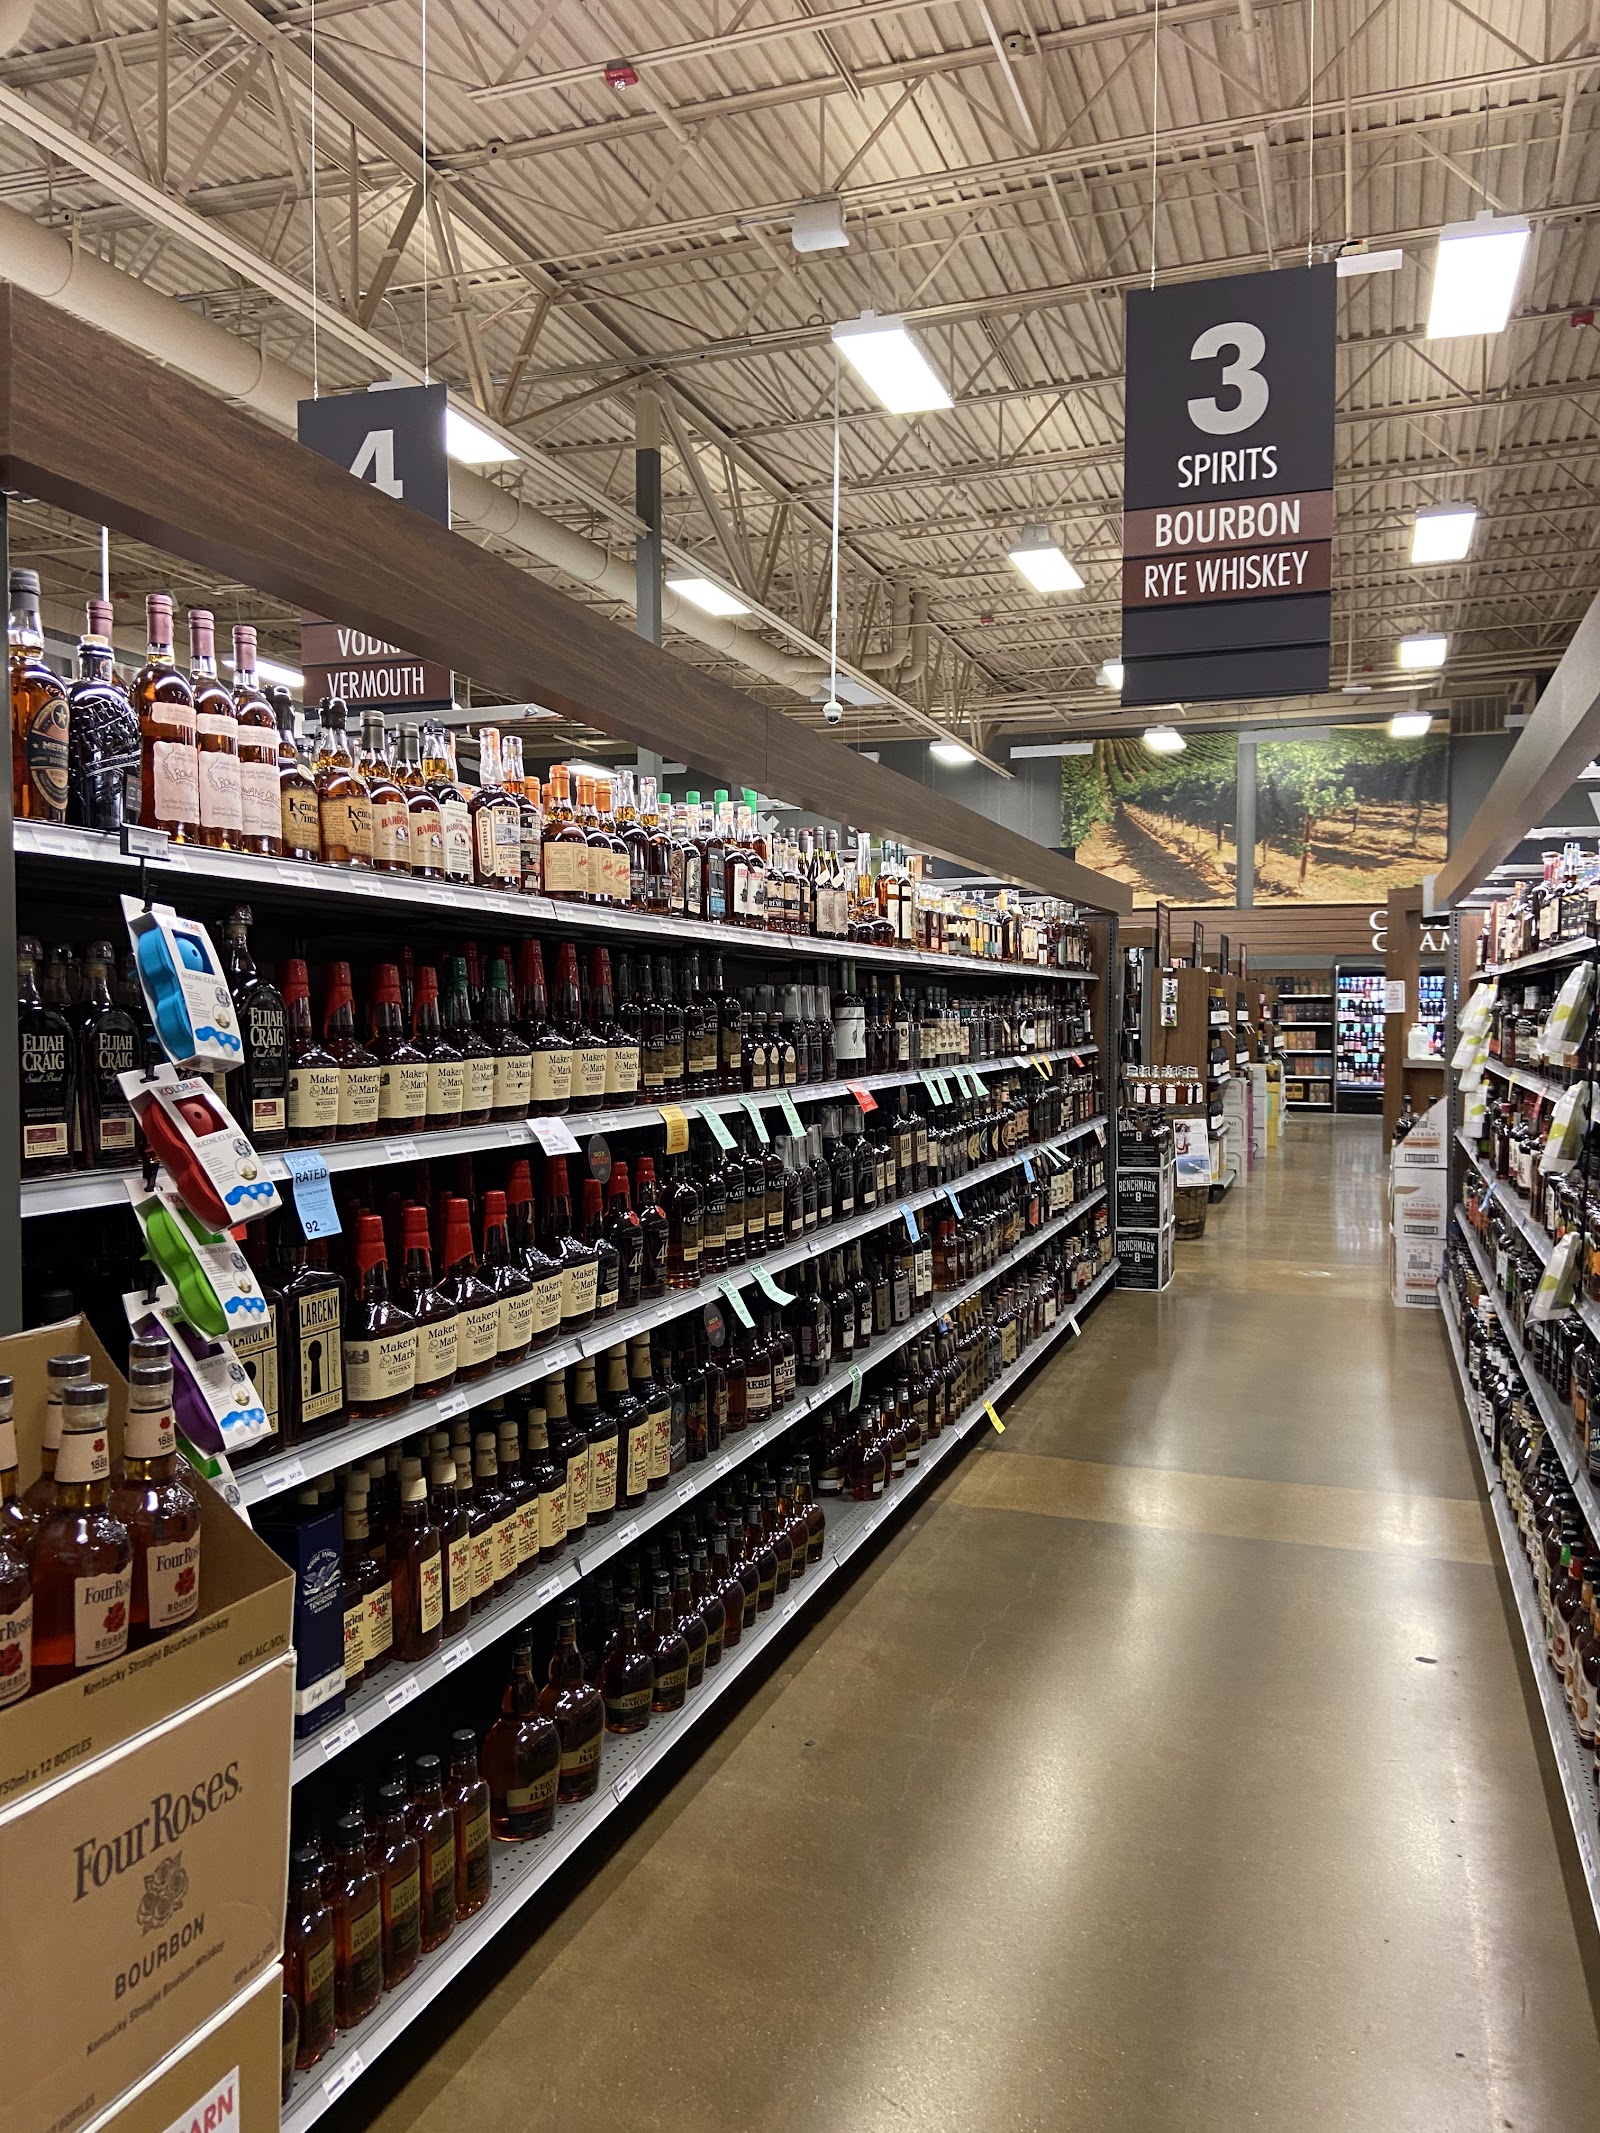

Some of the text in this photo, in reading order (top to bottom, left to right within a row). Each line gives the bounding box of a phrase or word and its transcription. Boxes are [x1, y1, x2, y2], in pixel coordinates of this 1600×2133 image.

[1187, 321, 1269, 435] 3
[349, 428, 404, 499] 4
[1177, 445, 1278, 488] SPIRITS
[1155, 499, 1300, 548] BOURBON
[1144, 550, 1309, 599] RYE WHISKEY
[326, 666, 425, 701] VERMOUTH
[250, 1007, 284, 1031] ELIJAH
[22, 1033, 65, 1055] ELIJAH
[99, 1032, 133, 1054] ELIJAH
[250, 1025, 284, 1048] CRAIG
[22, 1051, 65, 1073] CRAIG
[99, 1050, 133, 1070] CRAIG
[589, 1063, 606, 1073] Mark
[622, 1060, 638, 1070] Mark
[556, 1065, 572, 1075] Mark
[158, 1081, 202, 1097] KOLORAE
[320, 1085, 340, 1096] Mark
[358, 1084, 380, 1095] Mark
[194, 1138, 218, 1150] SILICONE
[226, 1131, 242, 1140] BALLS
[288, 1154, 320, 1168] HIGHLY
[295, 1167, 327, 1184] RATED
[1118, 1180, 1158, 1193] BENCHMARK
[305, 1220, 321, 1233] 92
[1117, 1240, 1156, 1254] BENCHMARK
[580, 1278, 597, 1290] Mark
[544, 1291, 562, 1304] Mark
[300, 1295, 338, 1329] LARCENY
[477, 1319, 499, 1335] Mark
[379, 1335, 416, 1355] Maker's
[439, 1334, 458, 1349] Mark
[392, 1348, 416, 1365] Mark
[156, 1554, 185, 1572] Four
[84, 1583, 115, 1606] Four
[344, 1610, 365, 1629] ncient
[83, 1616, 230, 1698] Kentucky Straight Bourbon Whiskey
[237, 1651, 254, 1667] 40%
[39, 1758, 52, 1776] 12
[54, 1736, 92, 1768] BOTTLES
[72, 1817, 151, 1904] Four
[115, 1912, 205, 2001] BOURBON
